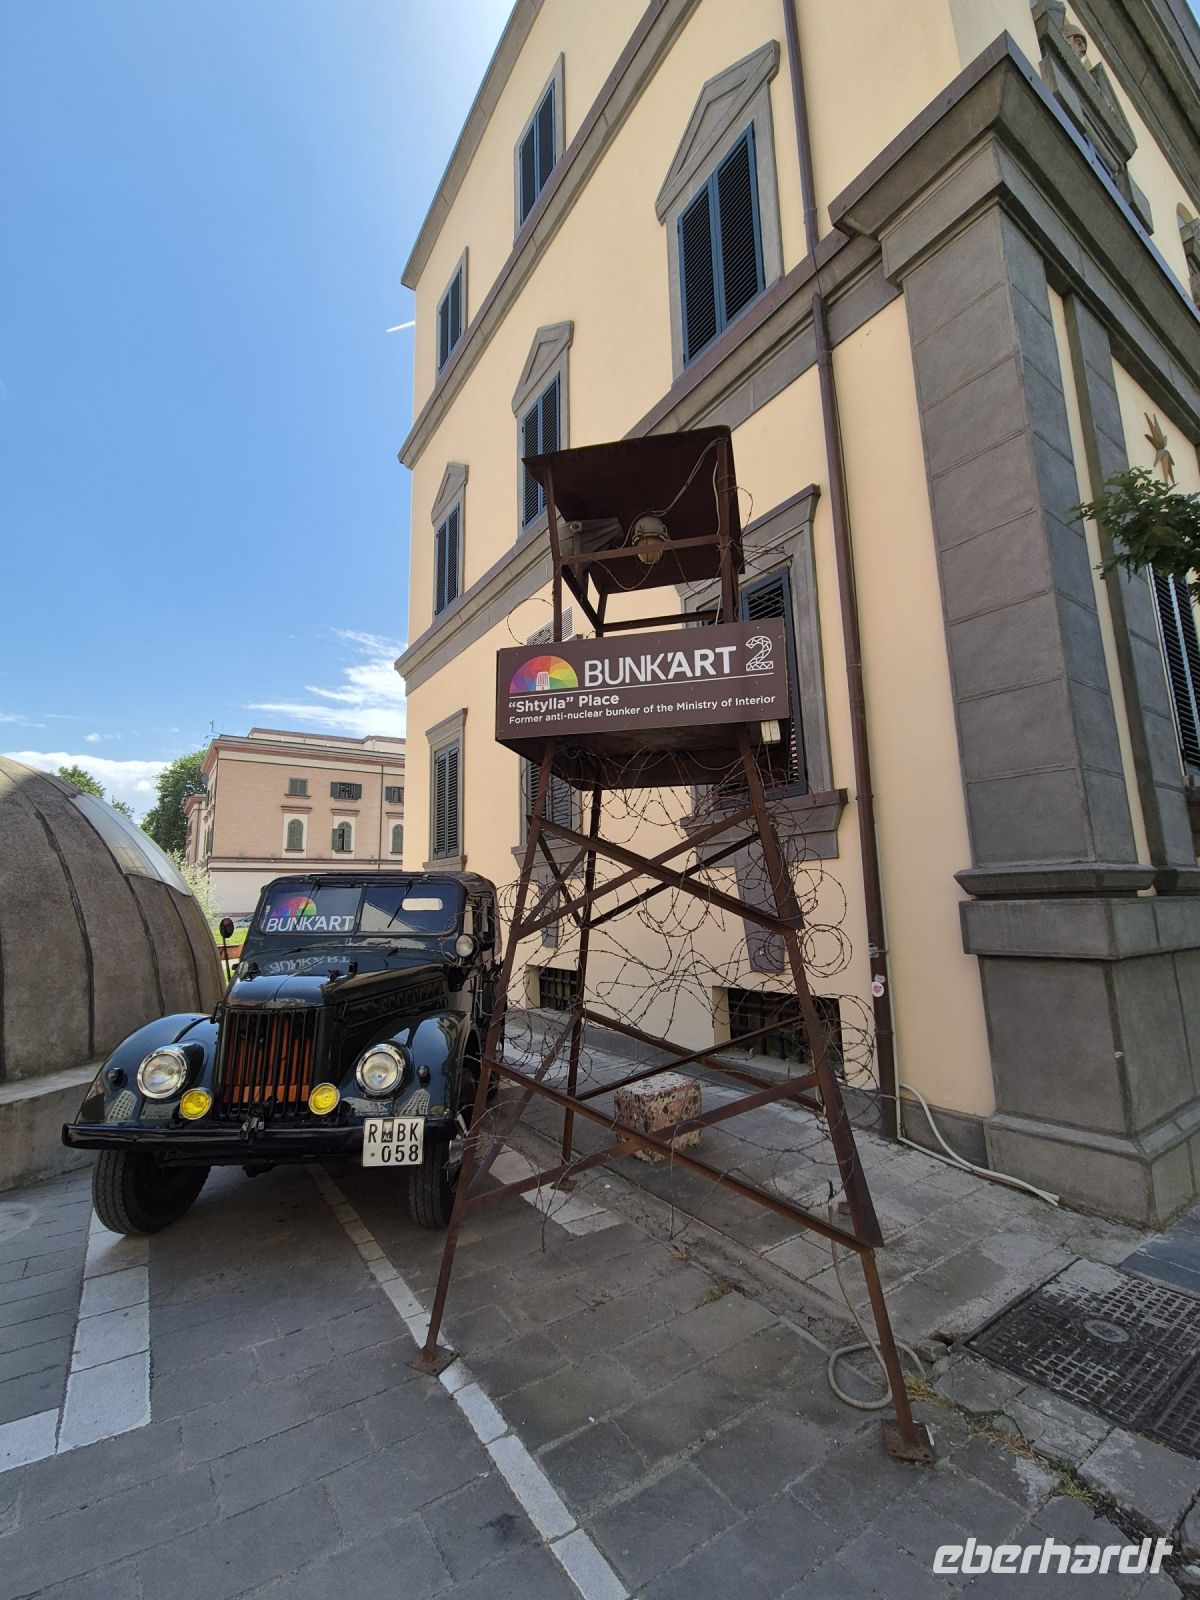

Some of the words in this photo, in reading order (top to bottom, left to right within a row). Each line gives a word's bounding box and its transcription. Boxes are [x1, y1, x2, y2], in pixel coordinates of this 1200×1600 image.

[583, 645, 737, 688] BUNK'ART
[745, 635, 774, 672] 2
[509, 714, 542, 725] Former
[545, 709, 603, 722] anti-nuclear
[605, 705, 640, 717] bunker
[643, 703, 655, 714] of
[656, 703, 674, 713] the
[676, 699, 718, 712] Ministry
[720, 697, 733, 708] of
[735, 694, 776, 706] Interior
[578, 694, 620, 707] Place
[367, 1123, 378, 1144] R
[396, 1121, 419, 1143] BK
[381, 1144, 419, 1163] 058
